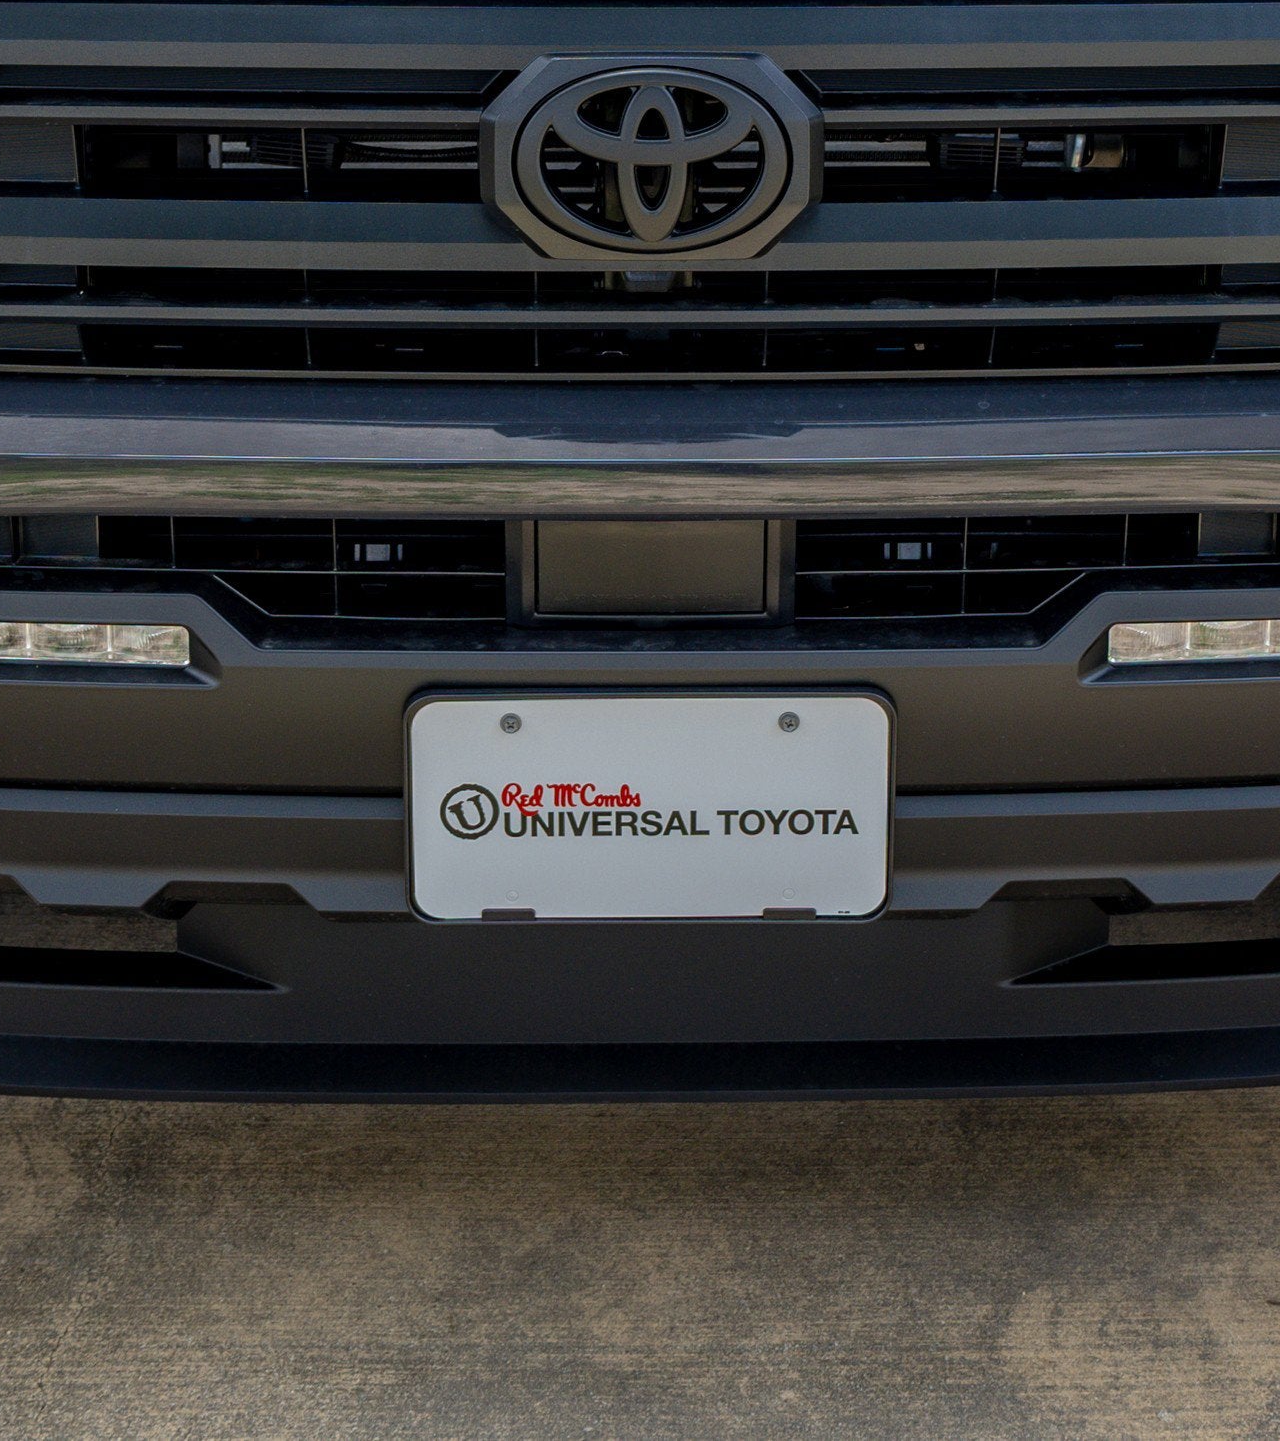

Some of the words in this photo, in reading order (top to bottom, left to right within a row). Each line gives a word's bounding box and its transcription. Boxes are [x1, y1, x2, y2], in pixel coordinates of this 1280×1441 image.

[501, 782, 544, 816] Red
[547, 782, 641, 807] McCombs
[503, 810, 710, 837] UNIVERSAL
[717, 809, 860, 835] TOYOTA
